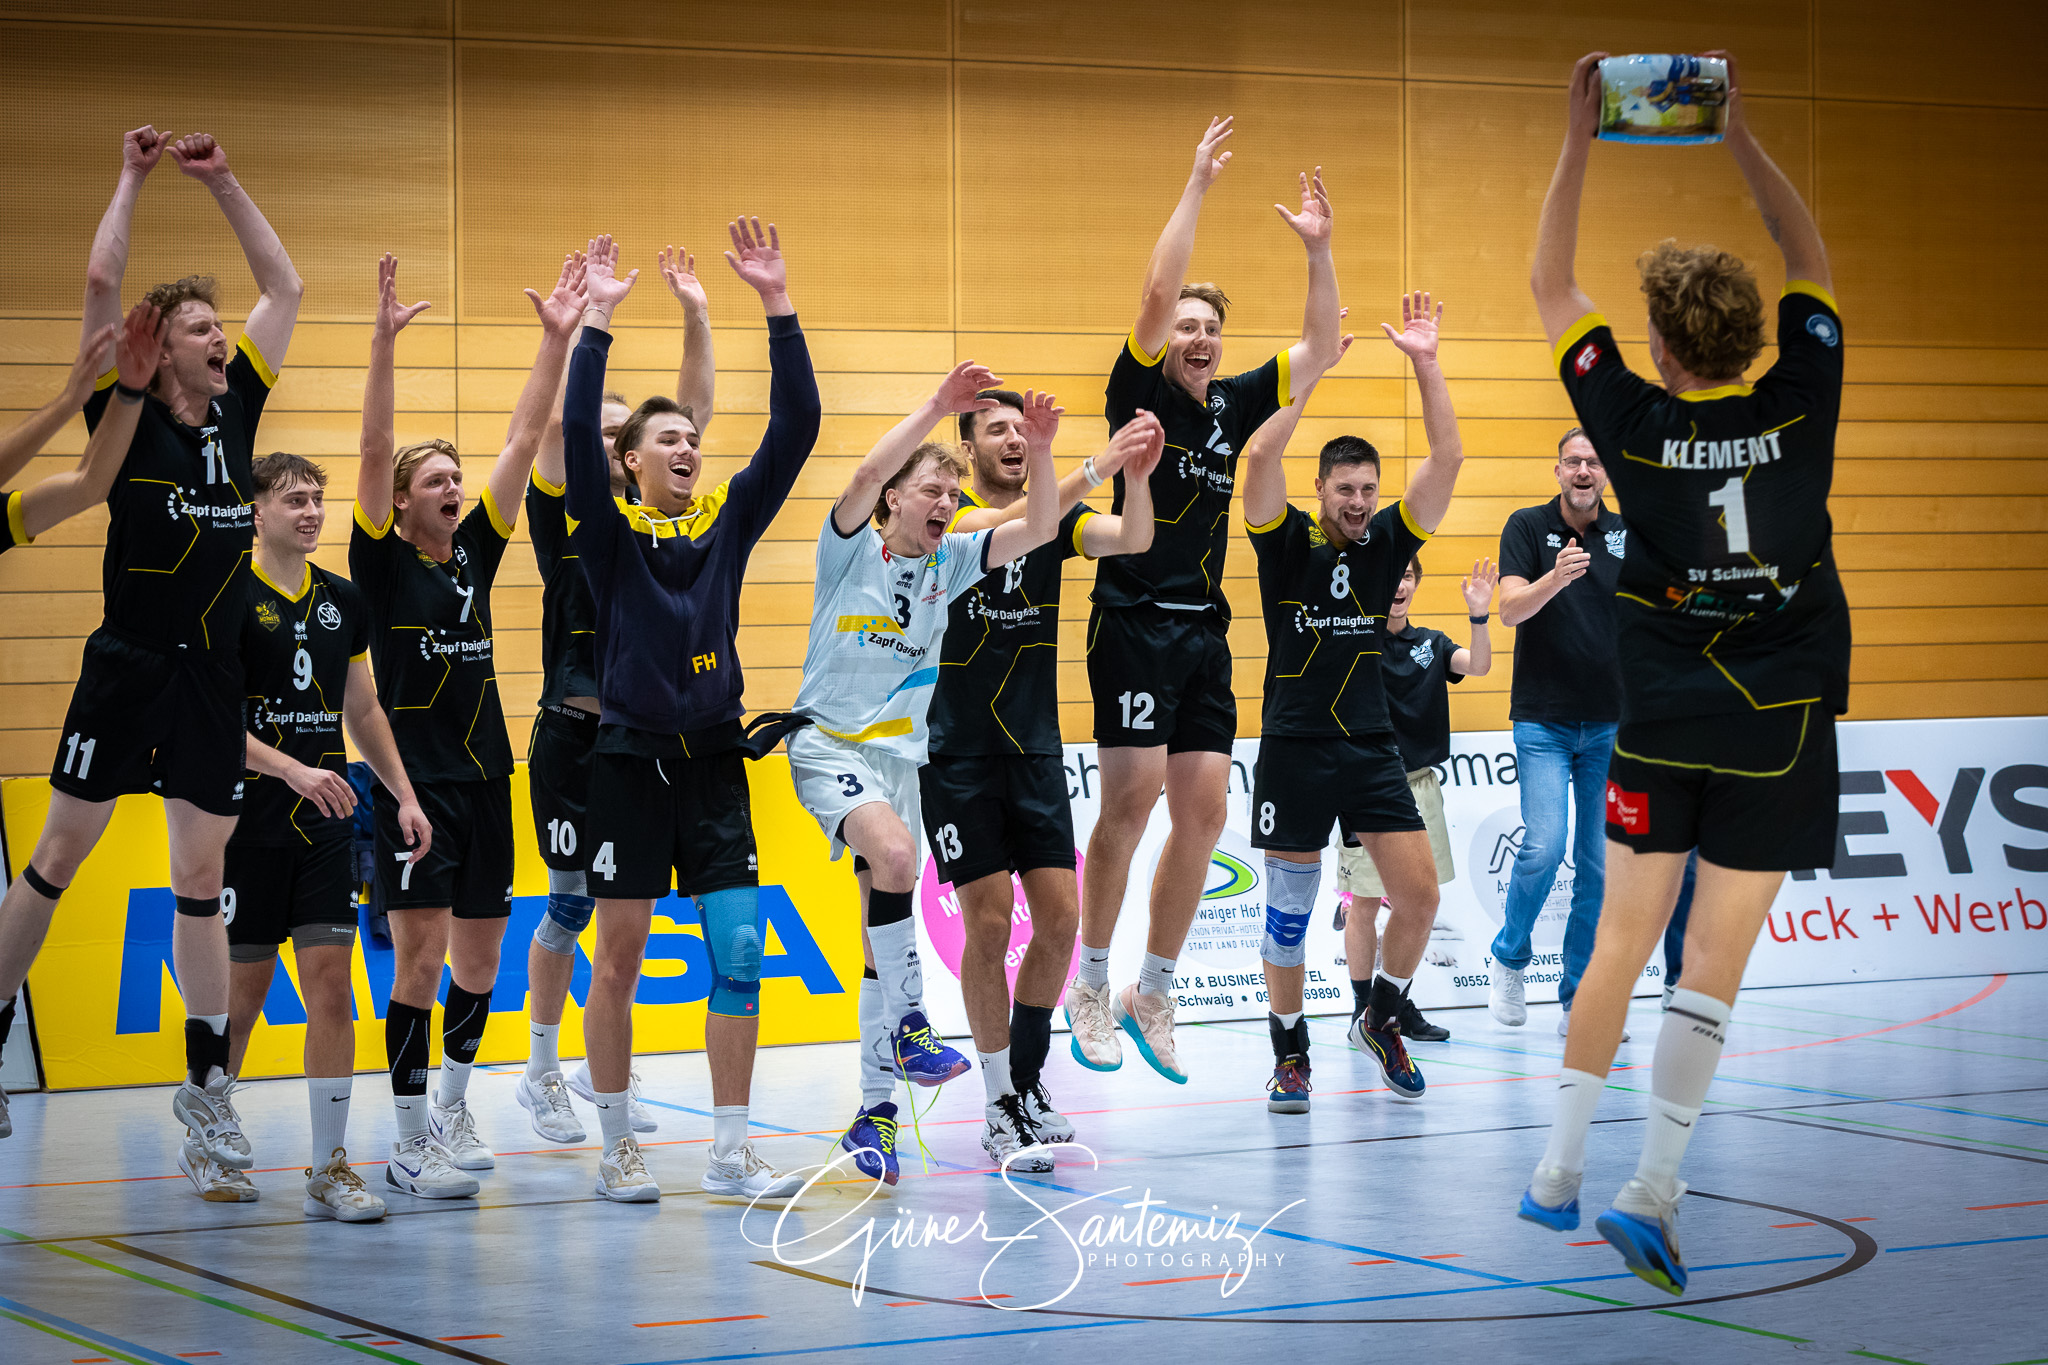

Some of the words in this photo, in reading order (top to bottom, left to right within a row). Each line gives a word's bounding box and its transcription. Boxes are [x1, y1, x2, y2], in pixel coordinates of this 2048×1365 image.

[201, 439, 230, 485] 11
[1661, 431, 1782, 470] KLEMENT
[181, 501, 209, 518] Zapf
[211, 503, 252, 519] Daigfuss
[1708, 476, 1750, 554] 1
[1330, 563, 1350, 600] 8
[1688, 568, 1708, 582] SV
[1712, 563, 1780, 581] Schwaig
[456, 586, 474, 622] 7
[893, 593, 912, 630] 3
[1305, 616, 1331, 629] Zapf
[1333, 615, 1375, 628] Daigfuss
[432, 641, 460, 655] Zapf
[868, 632, 896, 648] Zapf
[292, 648, 313, 691] 9
[692, 652, 717, 674] FH
[265, 711, 294, 725] Zapf
[296, 710, 338, 725] Daigfuss
[1118, 691, 1155, 731] 12
[63, 732, 97, 780] 11
[836, 773, 864, 798] 3
[1258, 801, 1276, 836] 8
[1791, 764, 2048, 881] EYS
[547, 818, 578, 857] 10
[936, 823, 964, 864] 13
[394, 851, 414, 891] 7
[592, 841, 617, 881] 4
[220, 886, 237, 926] 9
[1240, 902, 1261, 919] Hof
[1766, 896, 1859, 943] uck
[1188, 941, 1213, 951] STADT
[1217, 939, 1238, 950] LAND
[1195, 976, 1205, 989] &
[1207, 972, 1266, 988] BUSINES
[1453, 974, 1491, 988] 90552
[1177, 993, 1234, 1008] Schwaig
